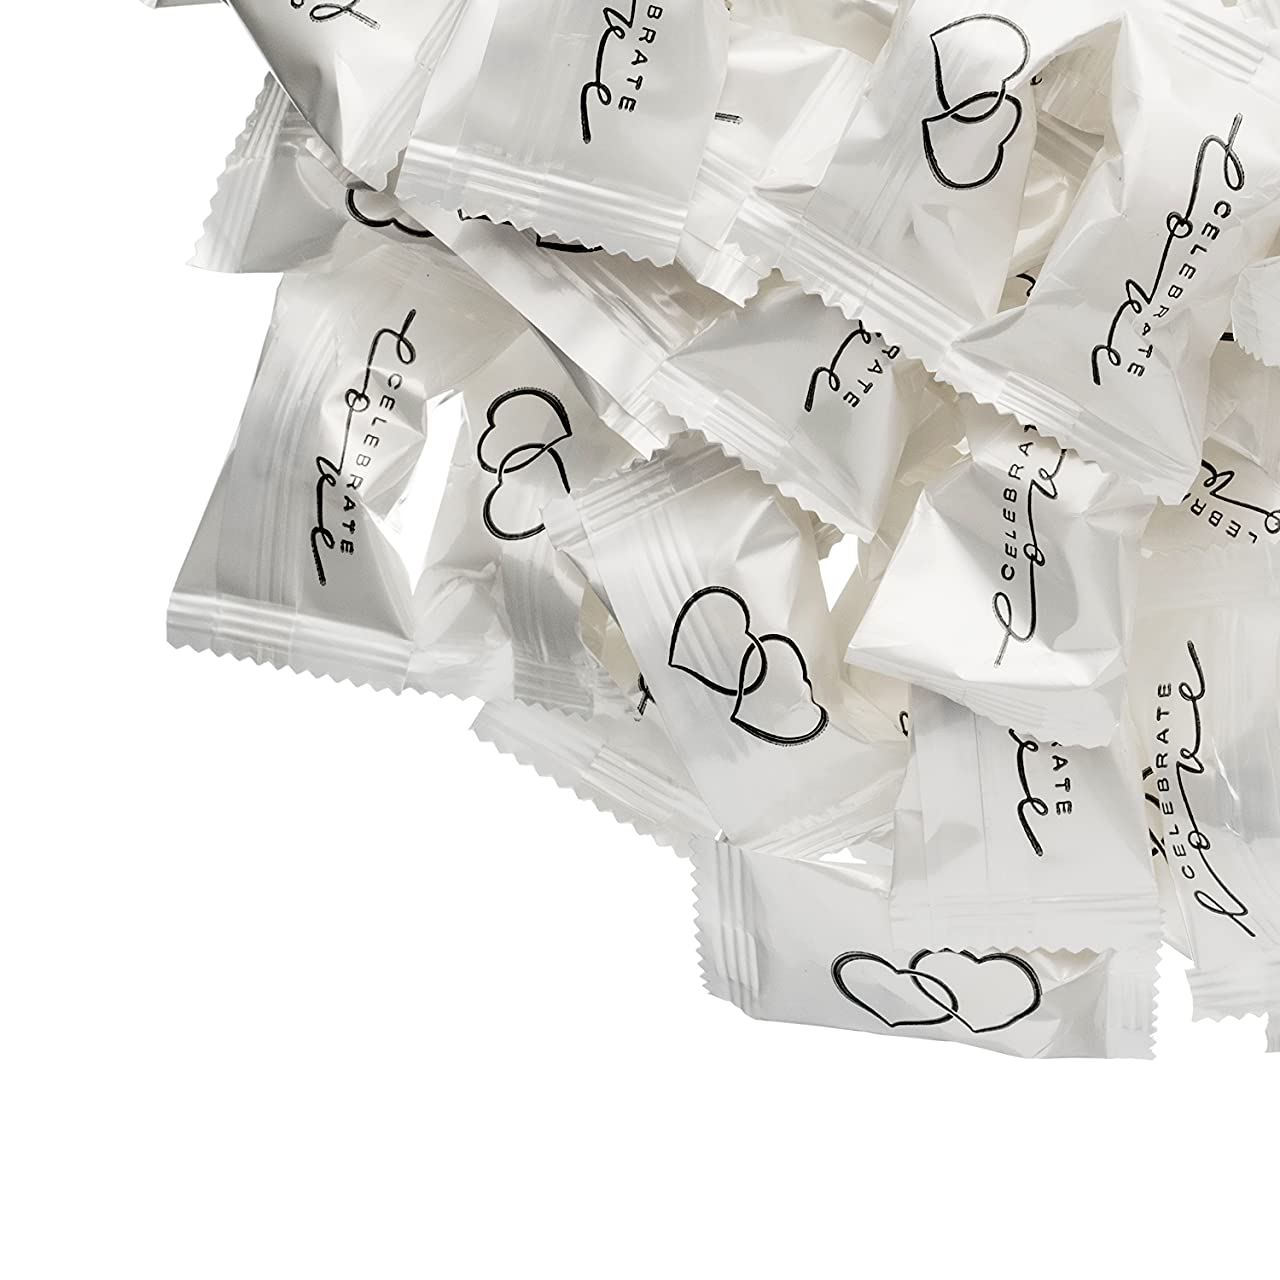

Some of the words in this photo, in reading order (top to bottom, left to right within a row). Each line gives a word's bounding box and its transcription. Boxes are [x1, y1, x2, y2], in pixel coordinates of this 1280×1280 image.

[1092, 113, 1245, 385] love
[1128, 200, 1232, 377] CELEBRATE
[311, 309, 416, 585] love
[339, 372, 402, 555] CELEBRATE
[1001, 425, 1037, 581] CELEBRA
[992, 449, 1067, 667] lov
[1156, 683, 1195, 879] CELEBRATE
[1176, 640, 1256, 937] love
